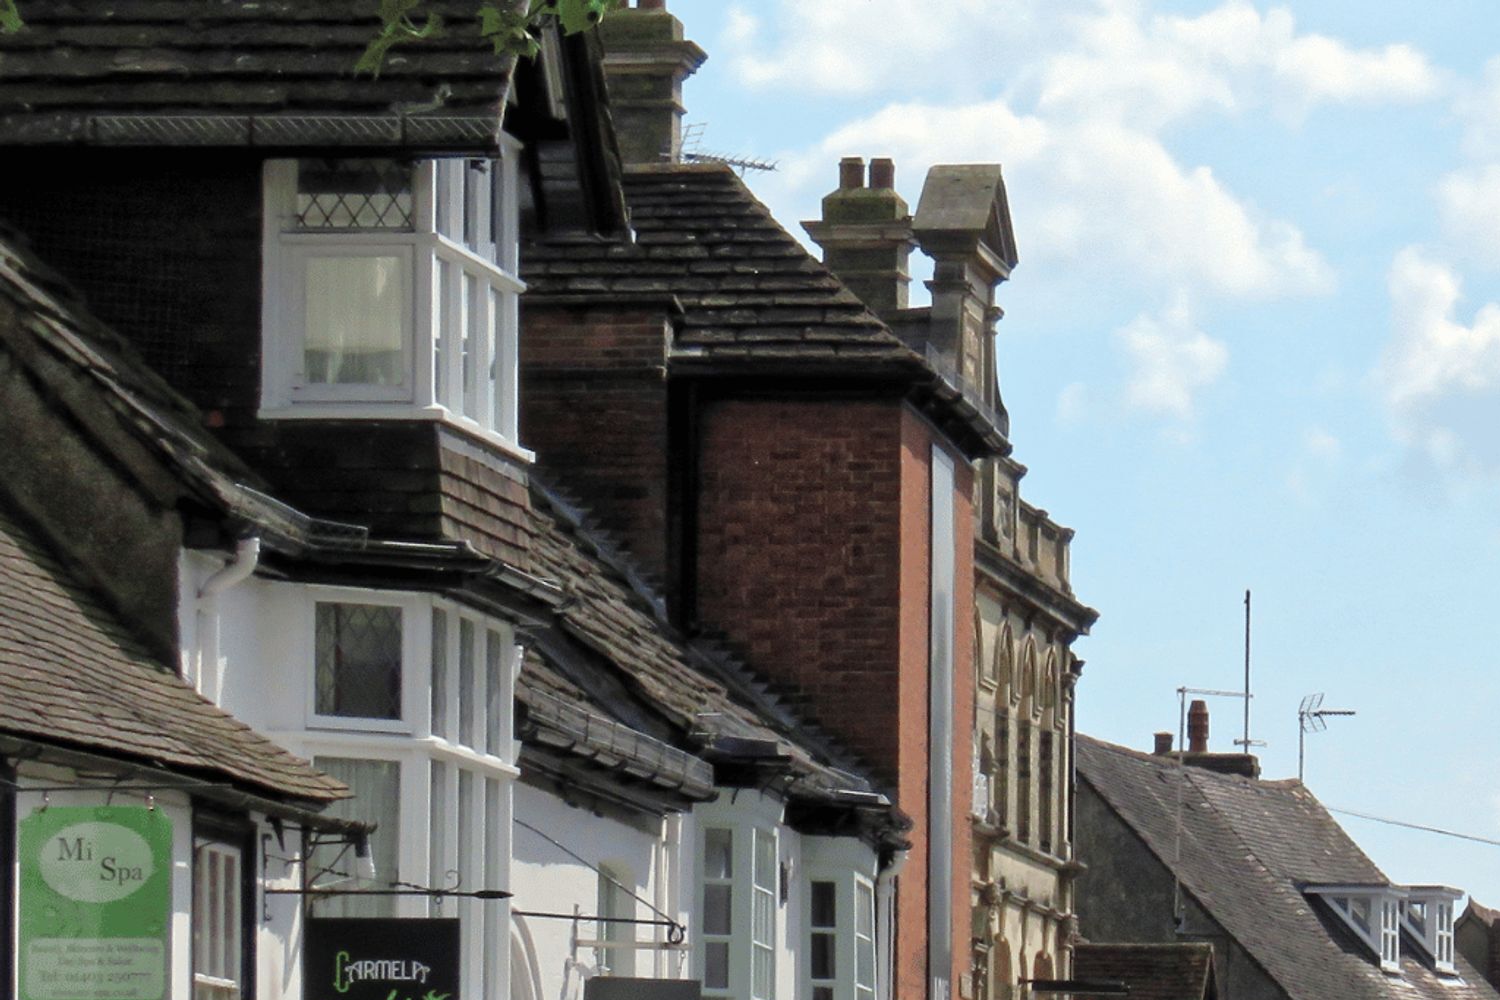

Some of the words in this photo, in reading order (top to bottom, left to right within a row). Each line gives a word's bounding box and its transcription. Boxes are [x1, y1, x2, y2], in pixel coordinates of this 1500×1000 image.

[57, 837, 93, 861] Mi
[100, 856, 143, 885] Spa
[334, 951, 431, 993] CARMELA
